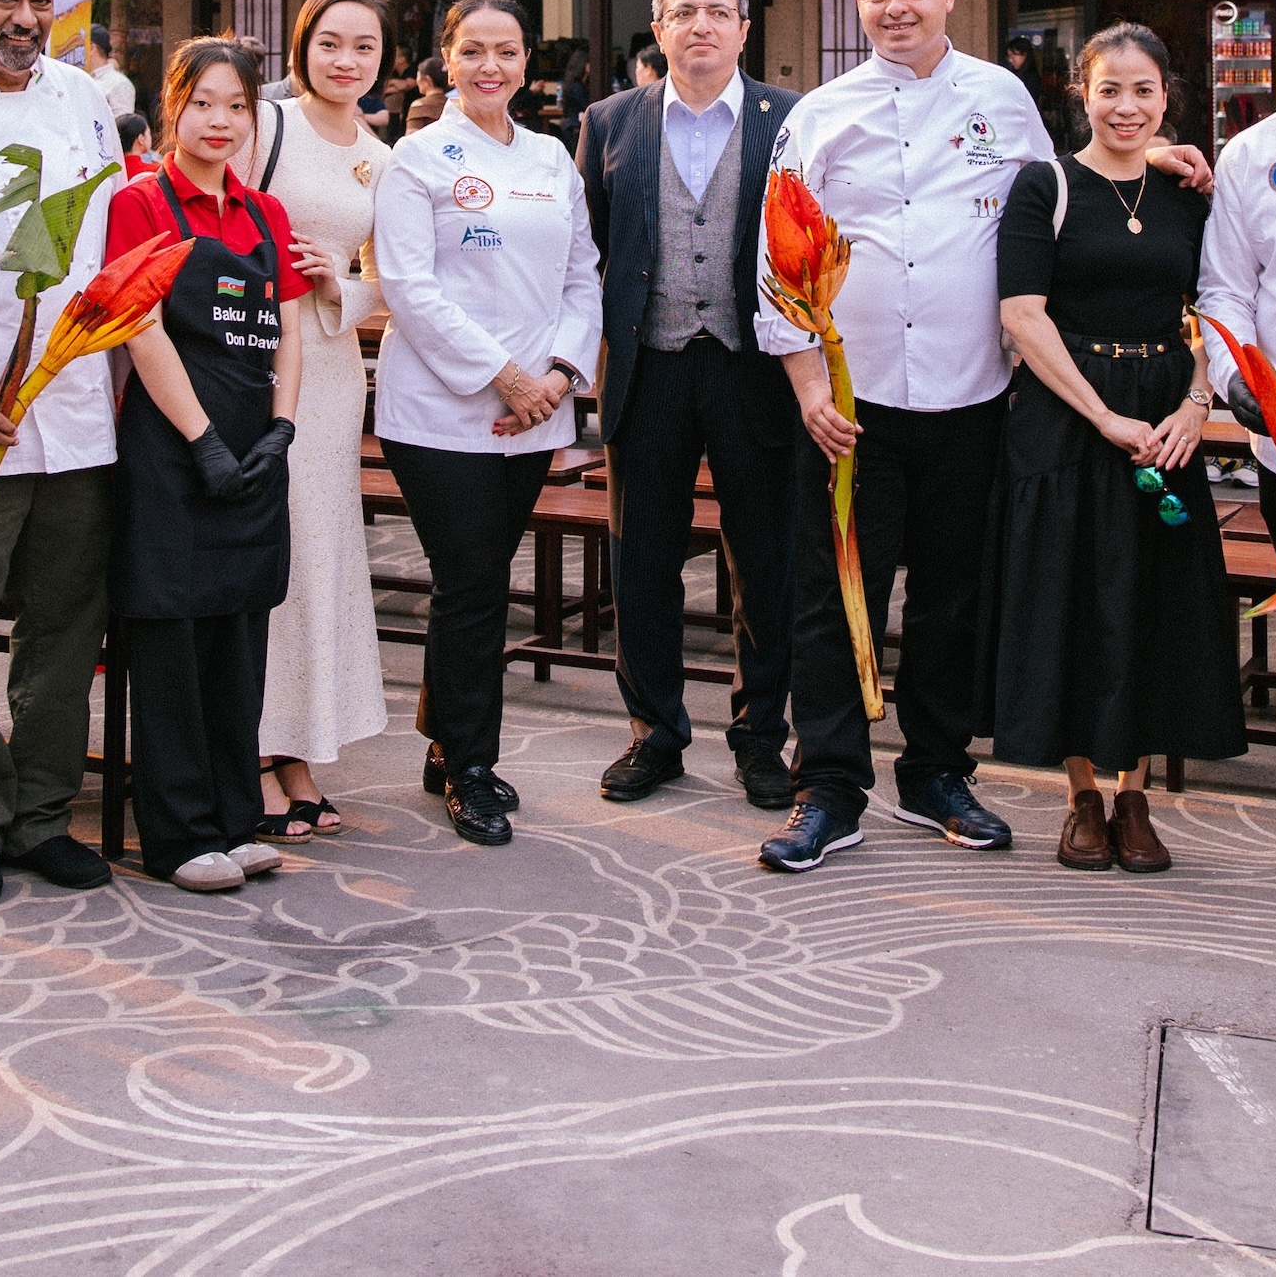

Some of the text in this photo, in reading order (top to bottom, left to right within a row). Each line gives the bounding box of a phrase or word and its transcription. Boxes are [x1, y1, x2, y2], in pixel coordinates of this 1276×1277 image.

[213, 306, 246, 322] Baku
[225, 332, 279, 350] Don David
